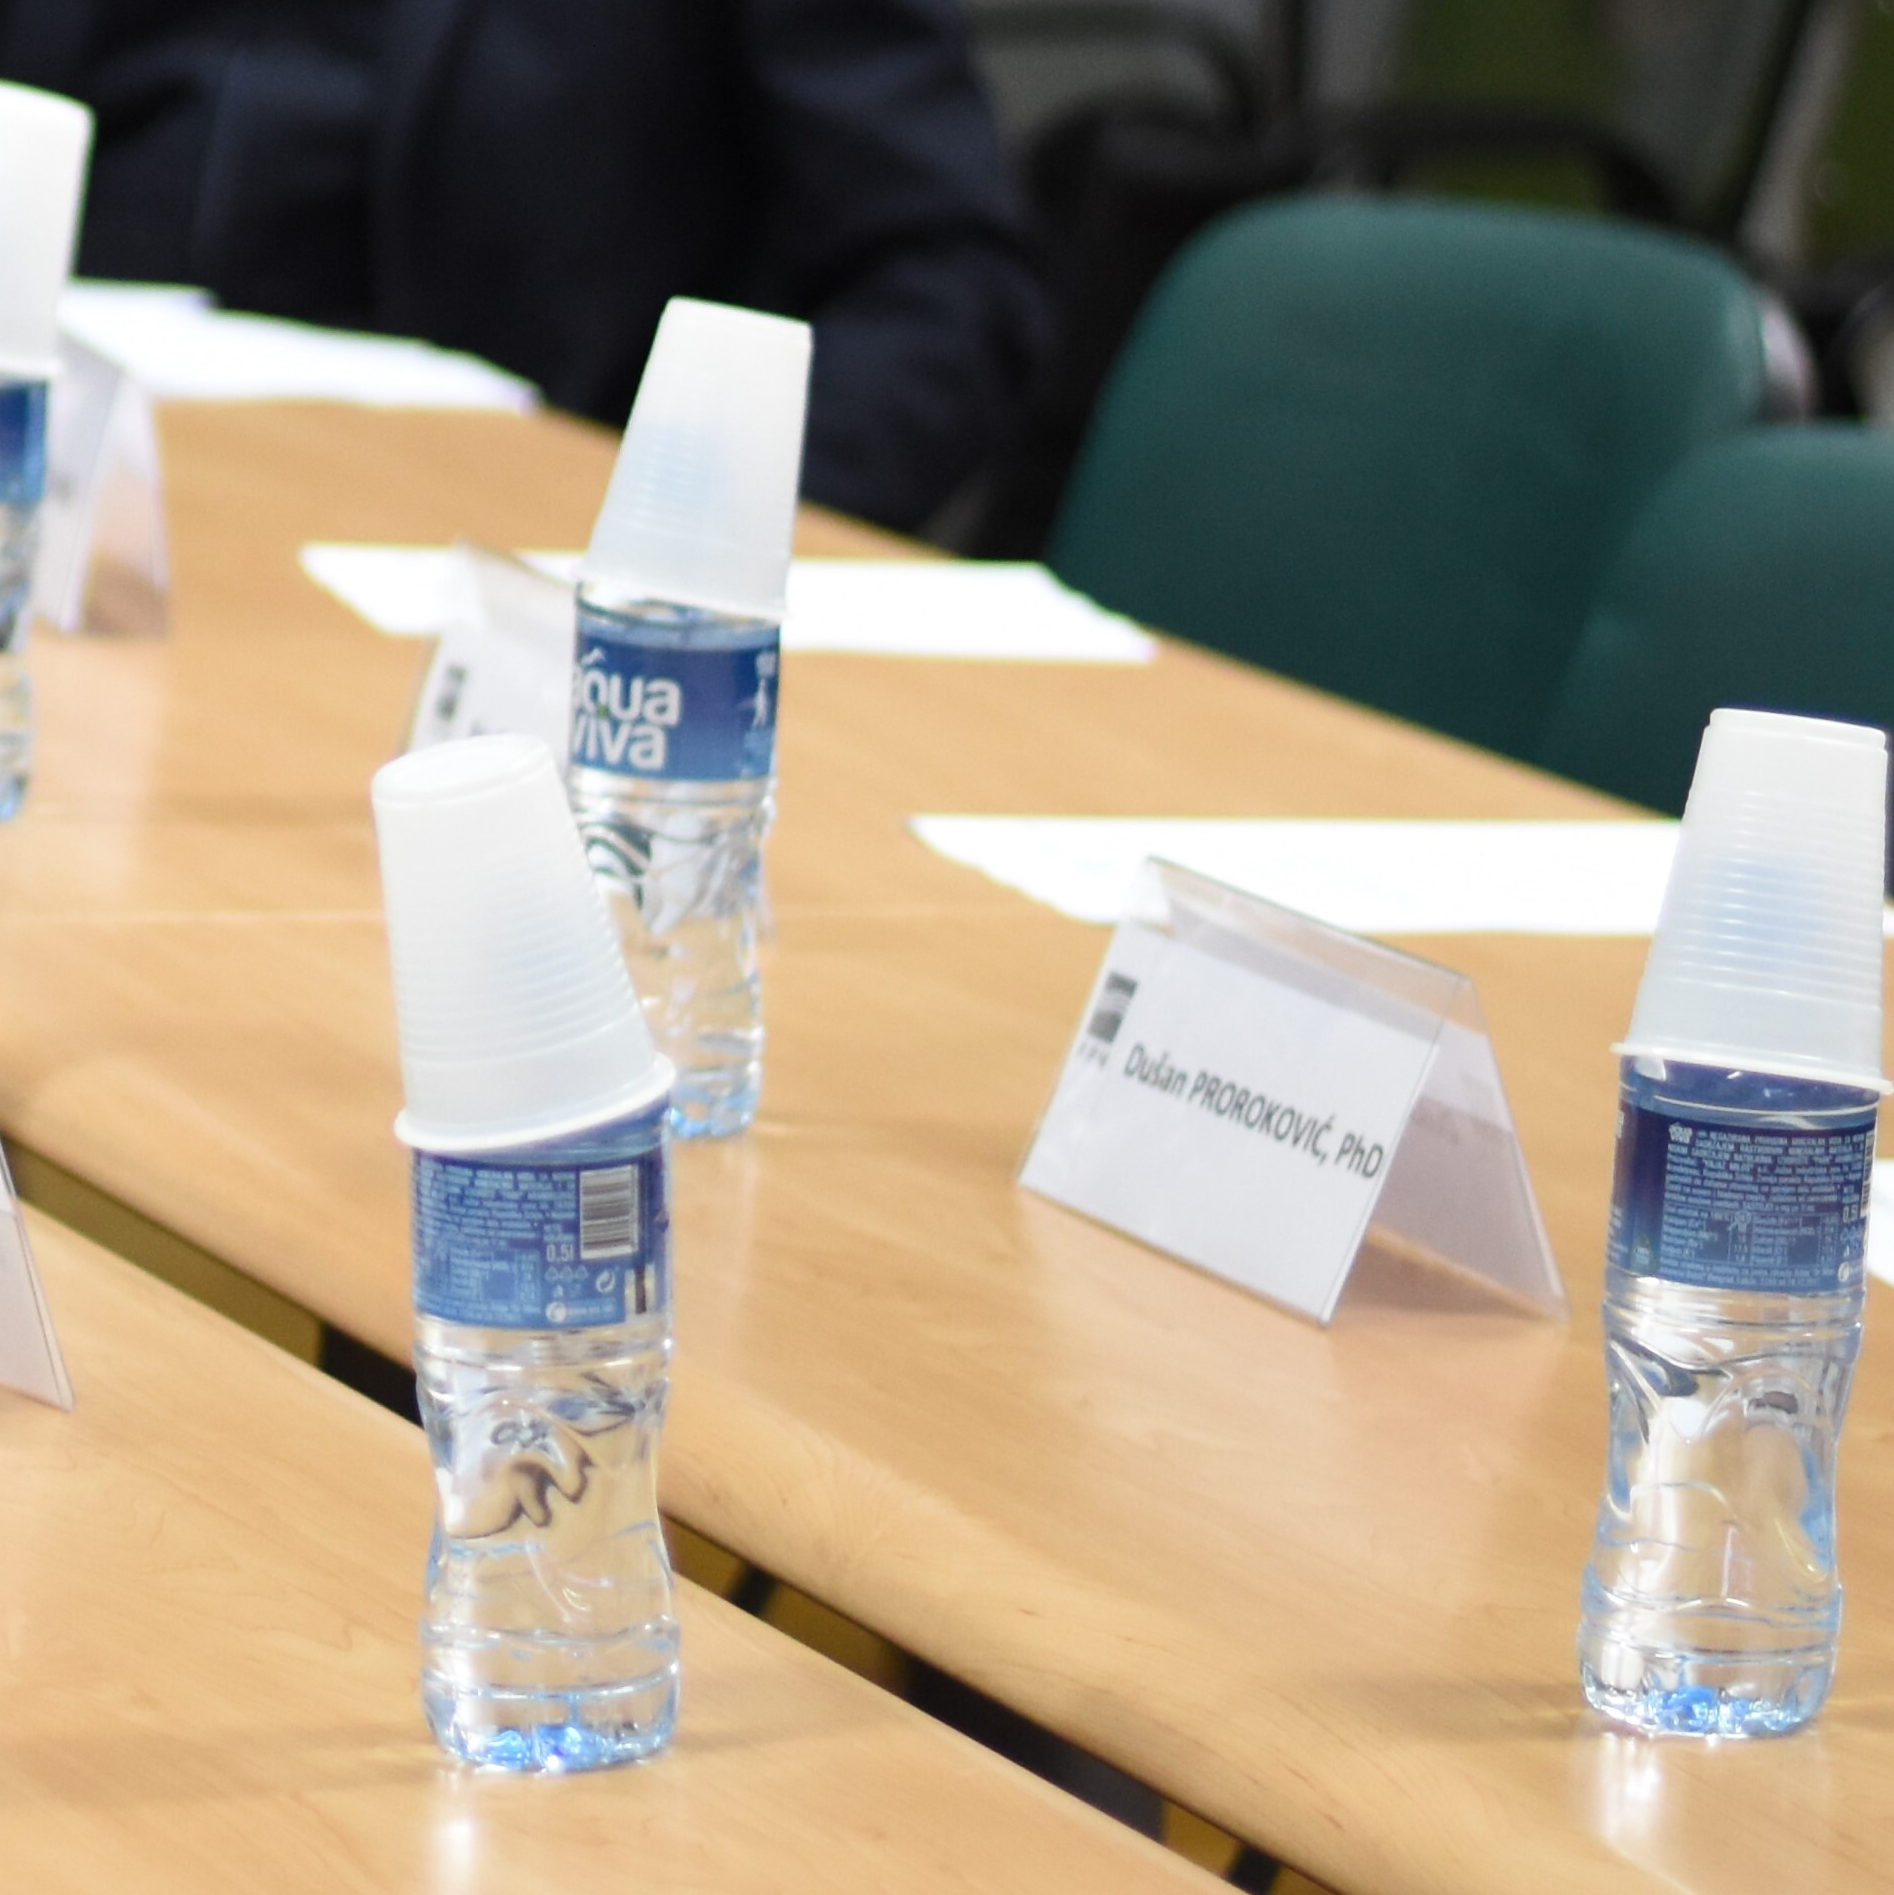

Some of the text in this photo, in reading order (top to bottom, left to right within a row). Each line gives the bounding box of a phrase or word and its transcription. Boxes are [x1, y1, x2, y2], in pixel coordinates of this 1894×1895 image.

[1123, 1042, 1385, 1180] Dušan PROROKOVIĆ, PhD
